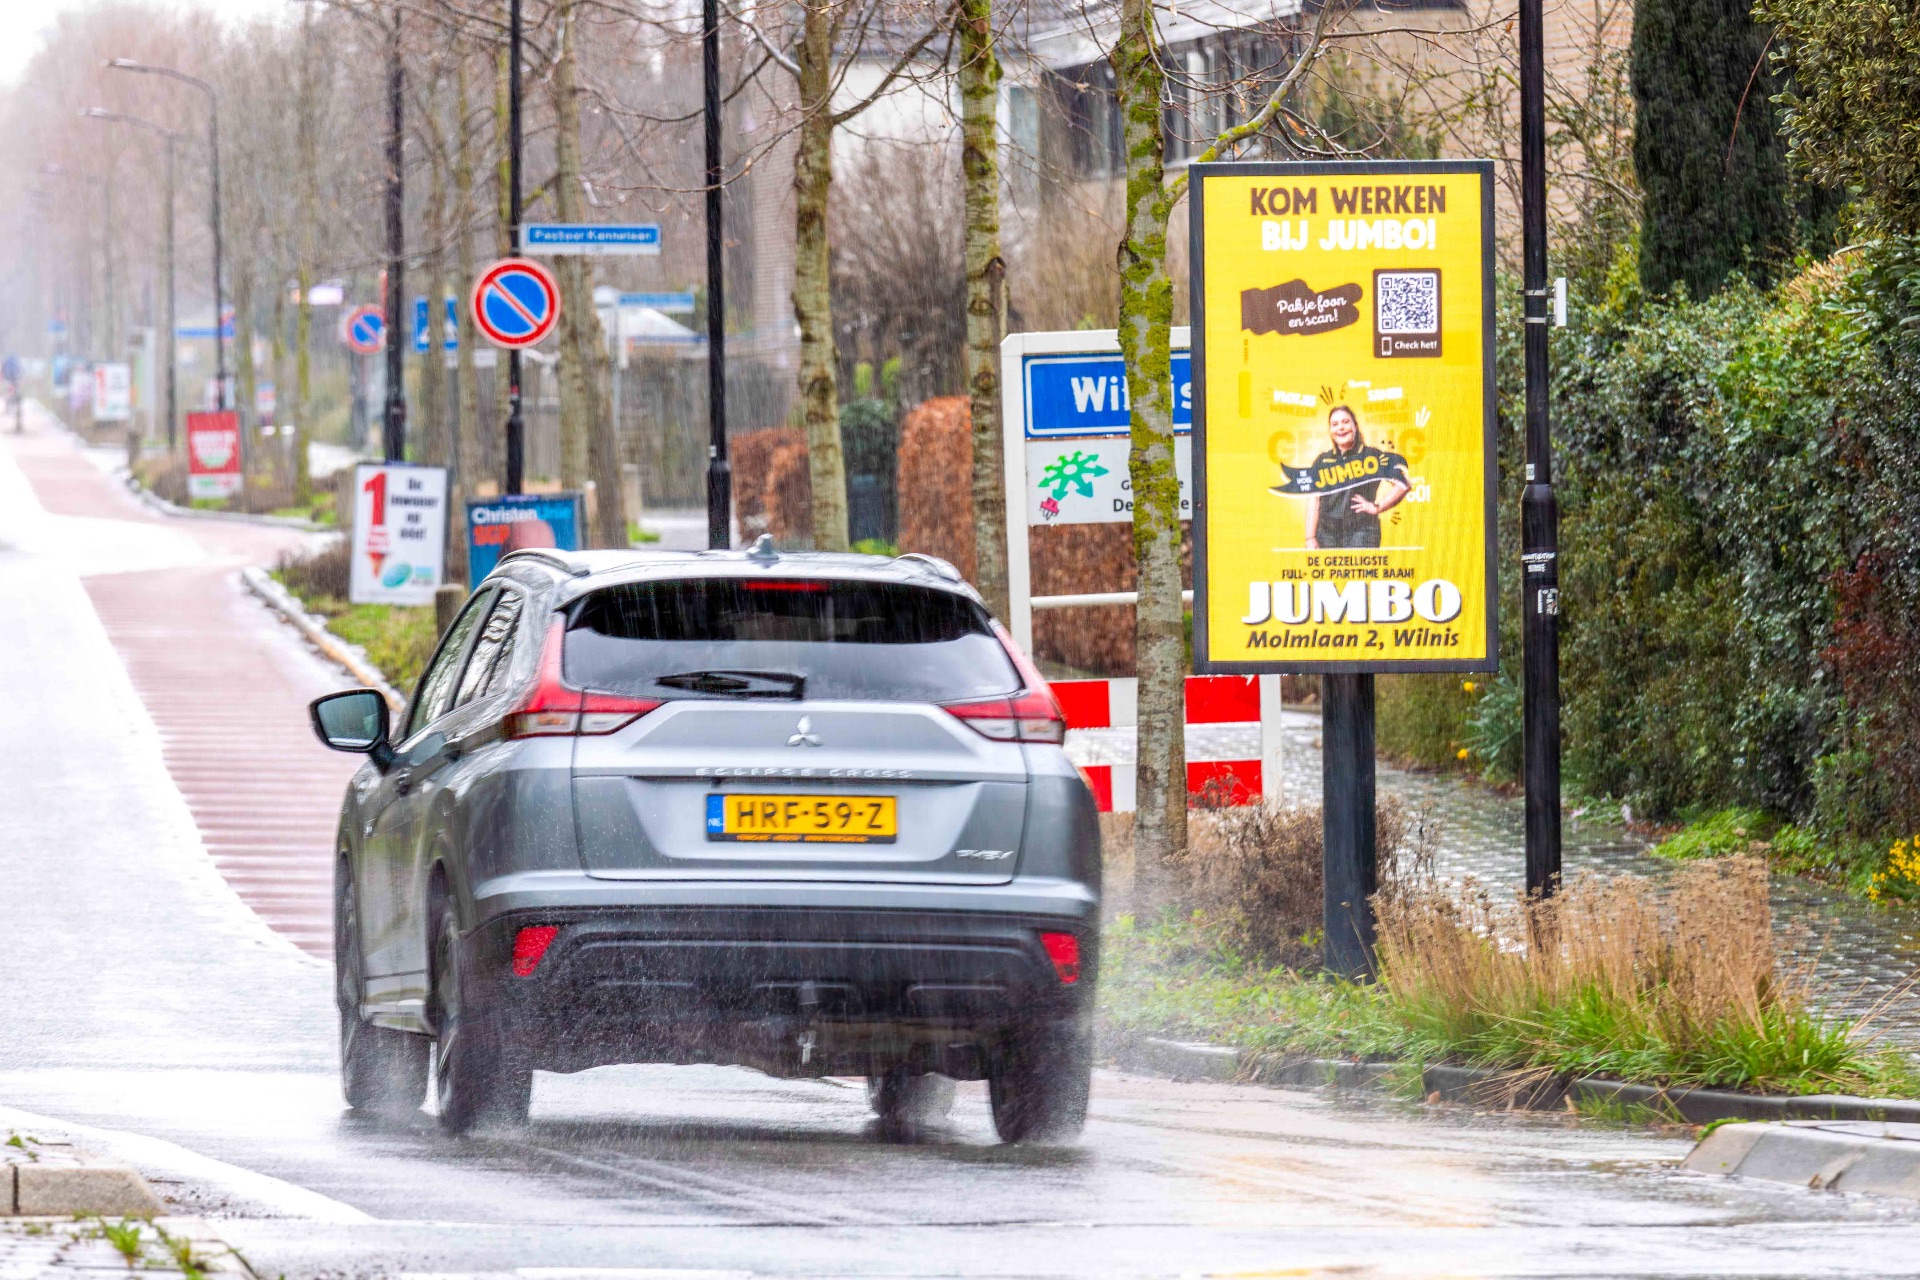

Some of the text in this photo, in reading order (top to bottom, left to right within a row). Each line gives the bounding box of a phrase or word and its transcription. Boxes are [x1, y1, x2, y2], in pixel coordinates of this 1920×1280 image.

[1250, 185, 1446, 216] KOM WERKEN
[1262, 218, 1436, 251] BIJ JUMBO!
[1277, 295, 1347, 314] Pak je foon
[1288, 309, 1339, 329] en scan!
[1394, 340, 1437, 350] Check het!
[1070, 374, 1192, 414] Wils
[1315, 456, 1379, 489] JUMBO
[363, 472, 387, 526] 1
[1113, 498, 1134, 512] De
[1307, 556, 1388, 566] DE GEZELLIGSTE
[1281, 569, 1307, 579] FULL-
[1312, 569, 1325, 579] OF
[1329, 569, 1379, 579] PARTTIME
[1241, 579, 1462, 625] JUMBO
[1246, 627, 1459, 651] Molmlaan 2, Wilnis
[695, 767, 914, 779] ECLIPSE CROSS
[737, 801, 883, 829] HRF-59-Z
